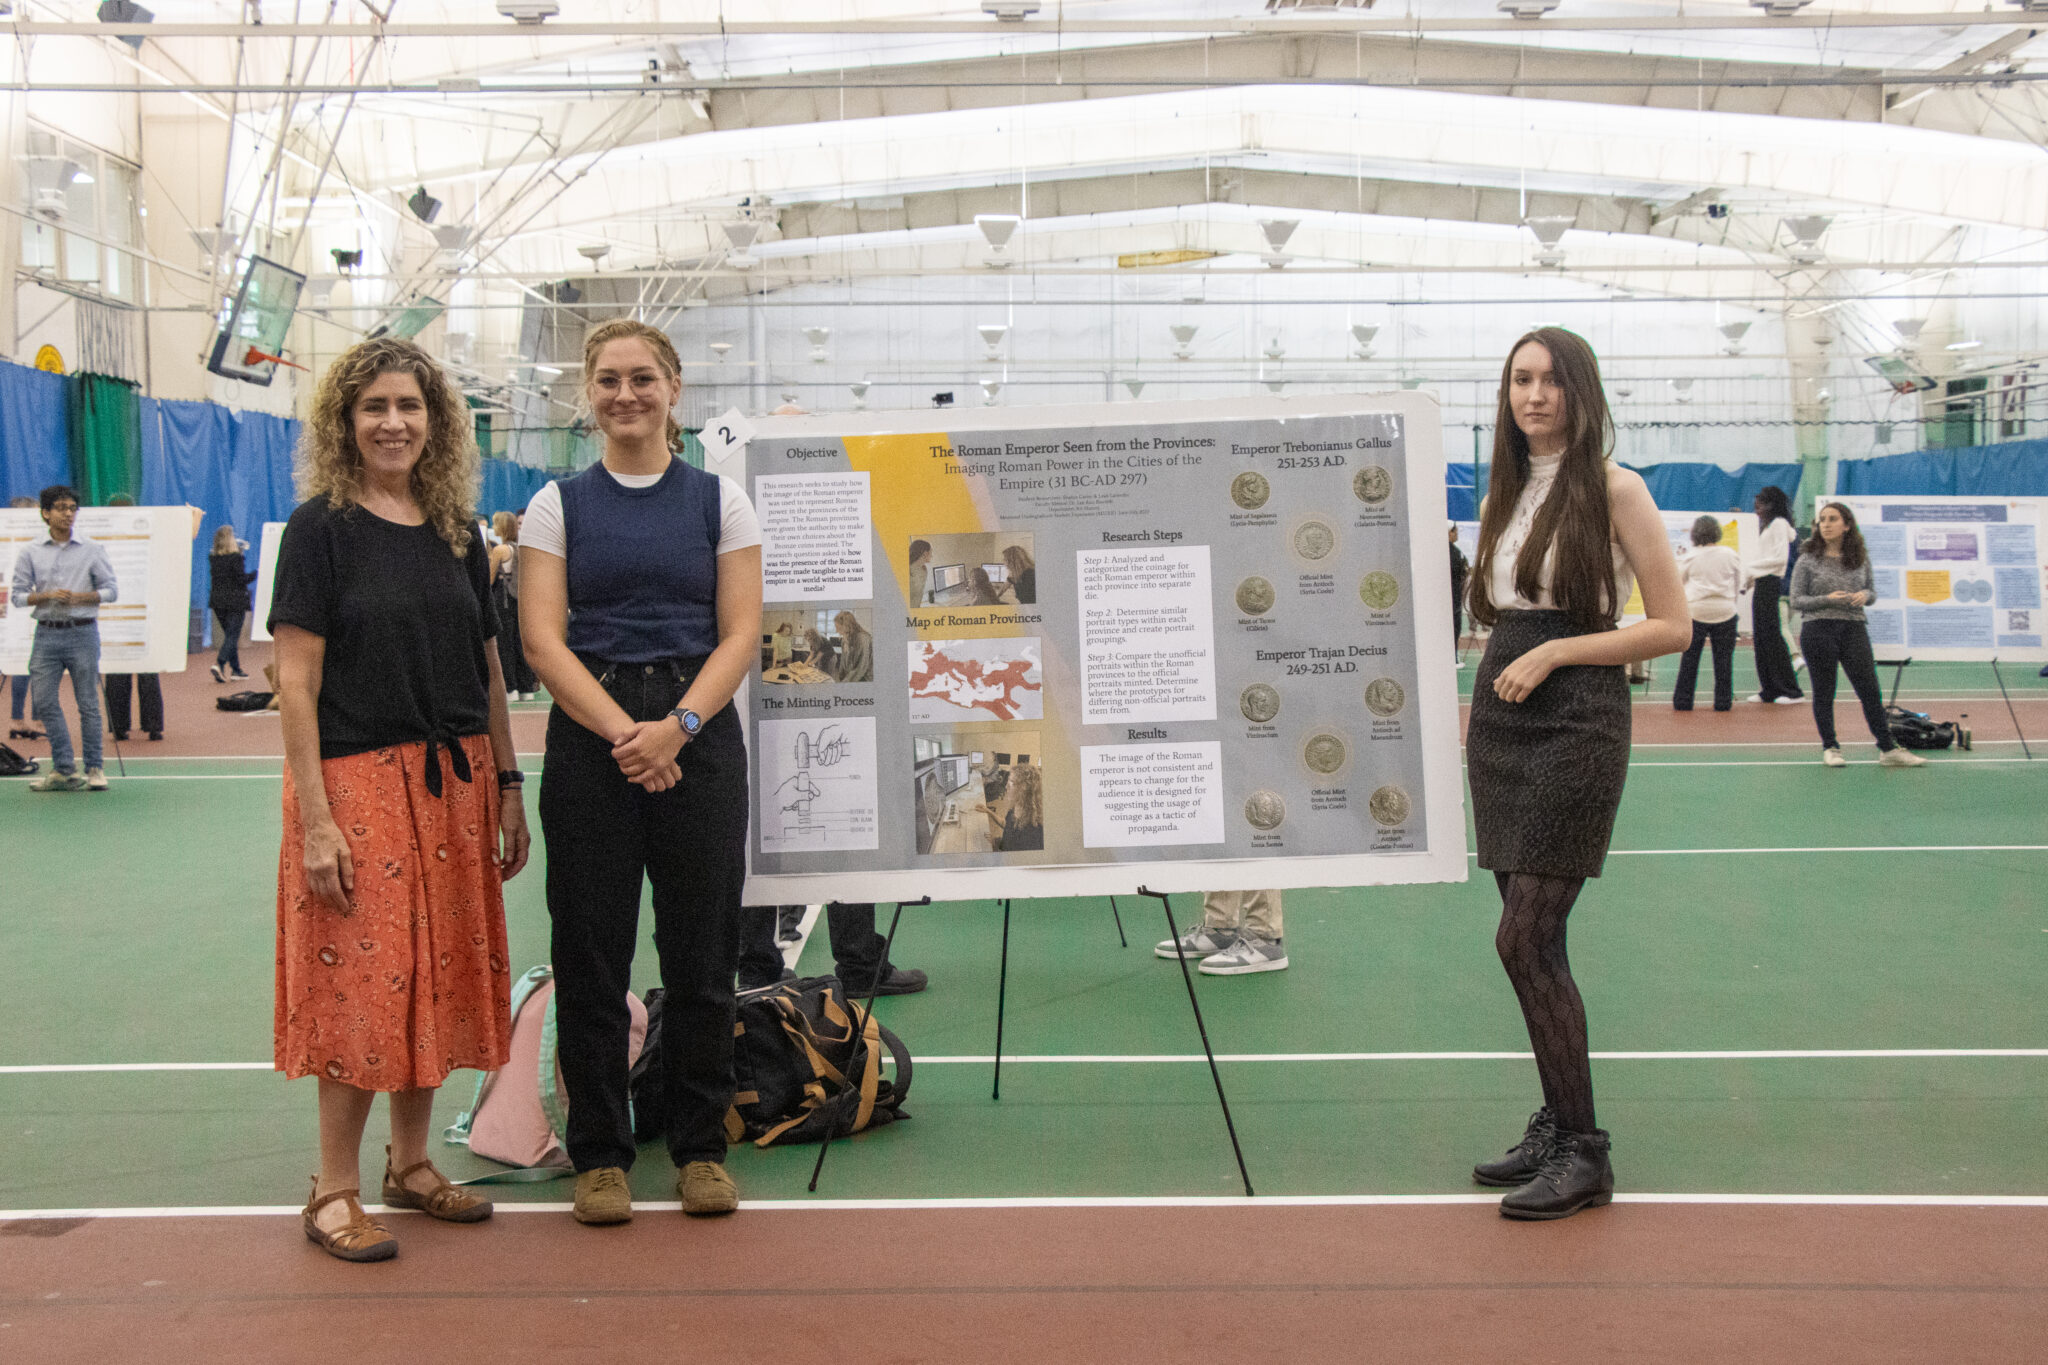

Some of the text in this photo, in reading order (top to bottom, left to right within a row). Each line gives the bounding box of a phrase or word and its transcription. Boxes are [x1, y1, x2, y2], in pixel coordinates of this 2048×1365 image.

[718, 426, 736, 446] 2
[929, 437, 1215, 456] The Roman Emperor Seen from the Provinces:
[1231, 438, 1392, 456] Emperor Trebonianus Gallus
[786, 447, 837, 460] Objective
[944, 454, 1201, 475] Imaging Roman Power in the Cities of the
[1277, 457, 1347, 467] 251-253 A.D.
[999, 473, 1147, 491] Empire (31 BC-AD 297)
[1102, 530, 1182, 541] Research Steps
[1084, 556, 1101, 565] Step
[1111, 554, 1147, 564] Analyzed
[1149, 554, 1164, 562] and
[764, 569, 791, 577] Emperor
[811, 567, 836, 576] tangible
[1084, 564, 1128, 574] categorized
[1130, 563, 1143, 571] the
[1145, 563, 1175, 572] coinage
[765, 577, 787, 586] empire
[1084, 573, 1102, 581] each
[1134, 573, 1167, 581] emperor
[1169, 570, 1195, 578] within
[1084, 582, 1102, 590] each
[1104, 581, 1138, 591] province
[1158, 580, 1191, 589] separate
[1086, 609, 1103, 618] Step
[1116, 607, 1158, 615] Determine
[1160, 606, 1187, 614] similar
[906, 613, 1041, 628] Map of Roman Provinces
[1086, 617, 1115, 627] portrait
[1117, 618, 1138, 626] types
[1168, 615, 1186, 623] each
[1086, 626, 1120, 636] province
[1121, 625, 1137, 633] and
[1164, 624, 1194, 634] portrait
[1087, 653, 1105, 662] Step
[1115, 652, 1151, 661] Compare
[1168, 649, 1206, 658] unofficial
[1256, 645, 1387, 661] Emperor Trajan Decius
[1087, 661, 1121, 671] portraits
[1123, 660, 1148, 668] within
[1286, 663, 1359, 674] 249-251 A.D.
[1088, 670, 1125, 680] provinces
[1137, 669, 1150, 677] the
[1152, 668, 1179, 676] official
[1088, 679, 1122, 689] portraits
[1156, 676, 1198, 685] Determine
[1114, 687, 1127, 695] the
[1129, 688, 1171, 697] prototypes
[762, 696, 874, 709] The Minting Process
[1088, 694, 1206, 706] differing non-official portraits
[1128, 728, 1167, 738] Results
[1100, 753, 1116, 761] The
[1118, 753, 1143, 762] image
[1145, 752, 1154, 760] of
[1156, 752, 1170, 760] the
[1089, 767, 1124, 775] emperor
[1152, 763, 1195, 772] consistent
[1197, 762, 1213, 770] and
[1099, 779, 1131, 787] appears
[1144, 776, 1174, 785] change
[1176, 775, 1188, 783] for
[1097, 786, 1206, 797] audience it is designed for
[1104, 800, 1148, 810] suggesting
[1166, 801, 1190, 809] usage
[1110, 812, 1142, 822] coinage
[1162, 811, 1185, 819] tactic
[1187, 810, 1196, 818] of
[1128, 823, 1180, 834] propaganda.
